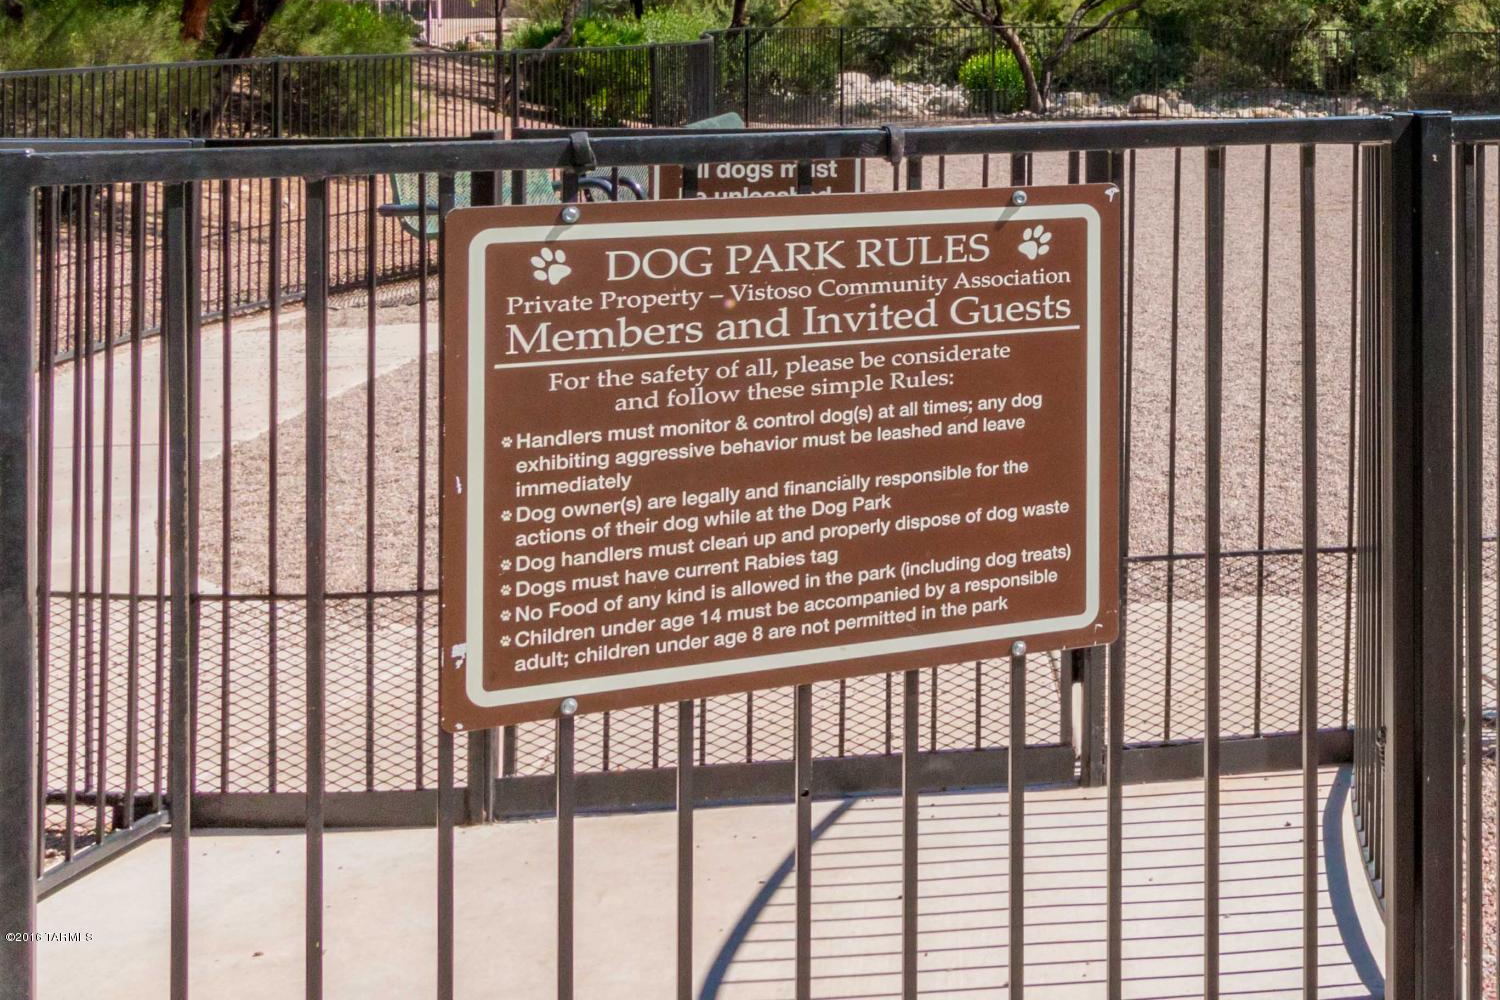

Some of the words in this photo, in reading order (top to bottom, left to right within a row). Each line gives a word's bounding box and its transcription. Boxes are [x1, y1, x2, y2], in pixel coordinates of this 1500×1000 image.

[716, 161, 774, 182] dogs
[780, 160, 838, 178] mst
[606, 247, 712, 280] DOG
[726, 241, 845, 274] PARK
[857, 234, 989, 268] RULES
[507, 296, 592, 315] Private
[600, 290, 703, 313] Property
[729, 283, 811, 303] Vistoso
[818, 274, 947, 298] Community
[953, 268, 1070, 289] Association
[506, 317, 703, 354] Members
[716, 307, 790, 341] and
[803, 298, 938, 335] Invited
[950, 295, 1071, 325] Guests
[549, 373, 590, 391] For
[597, 369, 633, 387] the
[641, 364, 709, 386] safety
[716, 360, 739, 379] of
[746, 358, 778, 377] all,
[786, 355, 854, 379] please
[860, 351, 885, 368] be
[892, 344, 1010, 366] considerate
[615, 390, 659, 411] and
[667, 387, 740, 407] follow
[748, 383, 804, 400] these
[811, 375, 883, 398] simple
[890, 370, 953, 389] Rules:
[516, 452, 609, 473] exhibiting
[615, 443, 715, 467] aggressive
[721, 436, 798, 455] behavior
[803, 431, 845, 447] must
[851, 429, 872, 443] be
[878, 422, 942, 441] leashed
[947, 419, 977, 435] and
[983, 418, 1025, 431] leave
[517, 430, 602, 449] Handlers
[608, 424, 654, 441] must
[660, 419, 731, 437] monitor
[736, 415, 748, 430] &
[753, 410, 814, 429] control
[820, 405, 873, 425] dog(s)
[878, 404, 894, 419] at
[899, 401, 918, 417] all
[923, 400, 972, 415] times;
[978, 398, 1007, 412] any
[1011, 393, 1042, 409] dog
[516, 473, 632, 497] immediately
[517, 507, 555, 523] Dog
[562, 496, 641, 517] owner(s)
[648, 496, 676, 509] are
[683, 487, 740, 508] legally
[745, 482, 778, 500] and
[784, 475, 870, 496] financially
[876, 465, 971, 488] responsible
[976, 463, 999, 477] for
[1003, 460, 1028, 474] the
[516, 528, 586, 547] actions
[592, 522, 611, 538] of
[616, 518, 658, 536] their
[663, 516, 698, 532] dog
[704, 509, 751, 527] while
[756, 507, 773, 521] at
[778, 504, 806, 519] the
[812, 501, 847, 517] Dog
[853, 494, 891, 512] Park
[516, 556, 555, 572] Dog
[562, 546, 643, 566] handlers
[649, 539, 694, 557] must
[700, 536, 747, 552] clean
[754, 533, 776, 548] up
[781, 525, 814, 543] and
[820, 518, 890, 542] properly
[895, 514, 960, 531] dispose
[965, 508, 982, 523] of
[987, 506, 1017, 522] dog
[1023, 500, 1069, 517] waste
[516, 580, 566, 597] Dogs
[572, 572, 619, 590] must
[625, 569, 669, 584] have
[675, 558, 739, 579] current
[745, 552, 805, 571] Rabies
[810, 550, 838, 565] tag
[516, 606, 542, 622] No
[549, 598, 597, 618] Food
[604, 595, 623, 611] of
[628, 594, 661, 610] any
[667, 585, 705, 604] kind
[711, 584, 726, 599] is
[731, 575, 799, 597] allowed
[805, 574, 820, 588] in
[825, 571, 853, 585] the
[858, 564, 896, 585] park
[901, 556, 980, 580] (including
[986, 552, 1016, 568] dog
[1021, 544, 1071, 562] treats)
[515, 627, 595, 647] Children
[601, 618, 656, 637] under
[661, 615, 694, 632] age
[701, 608, 721, 624] 14
[728, 603, 771, 621] must
[777, 601, 799, 615] be
[804, 584, 919, 612] accompanied
[925, 583, 945, 599] by
[950, 583, 960, 594] a
[965, 569, 1057, 593] responsible
[515, 652, 568, 671] adult;
[575, 644, 649, 664] children
[656, 635, 709, 653] under
[714, 632, 747, 648] age
[752, 626, 763, 641] 8
[768, 625, 796, 639] are
[802, 619, 829, 635] not
[835, 607, 916, 634] permitted
[922, 606, 936, 619] in
[941, 602, 967, 617] the
[972, 596, 1008, 617] park
